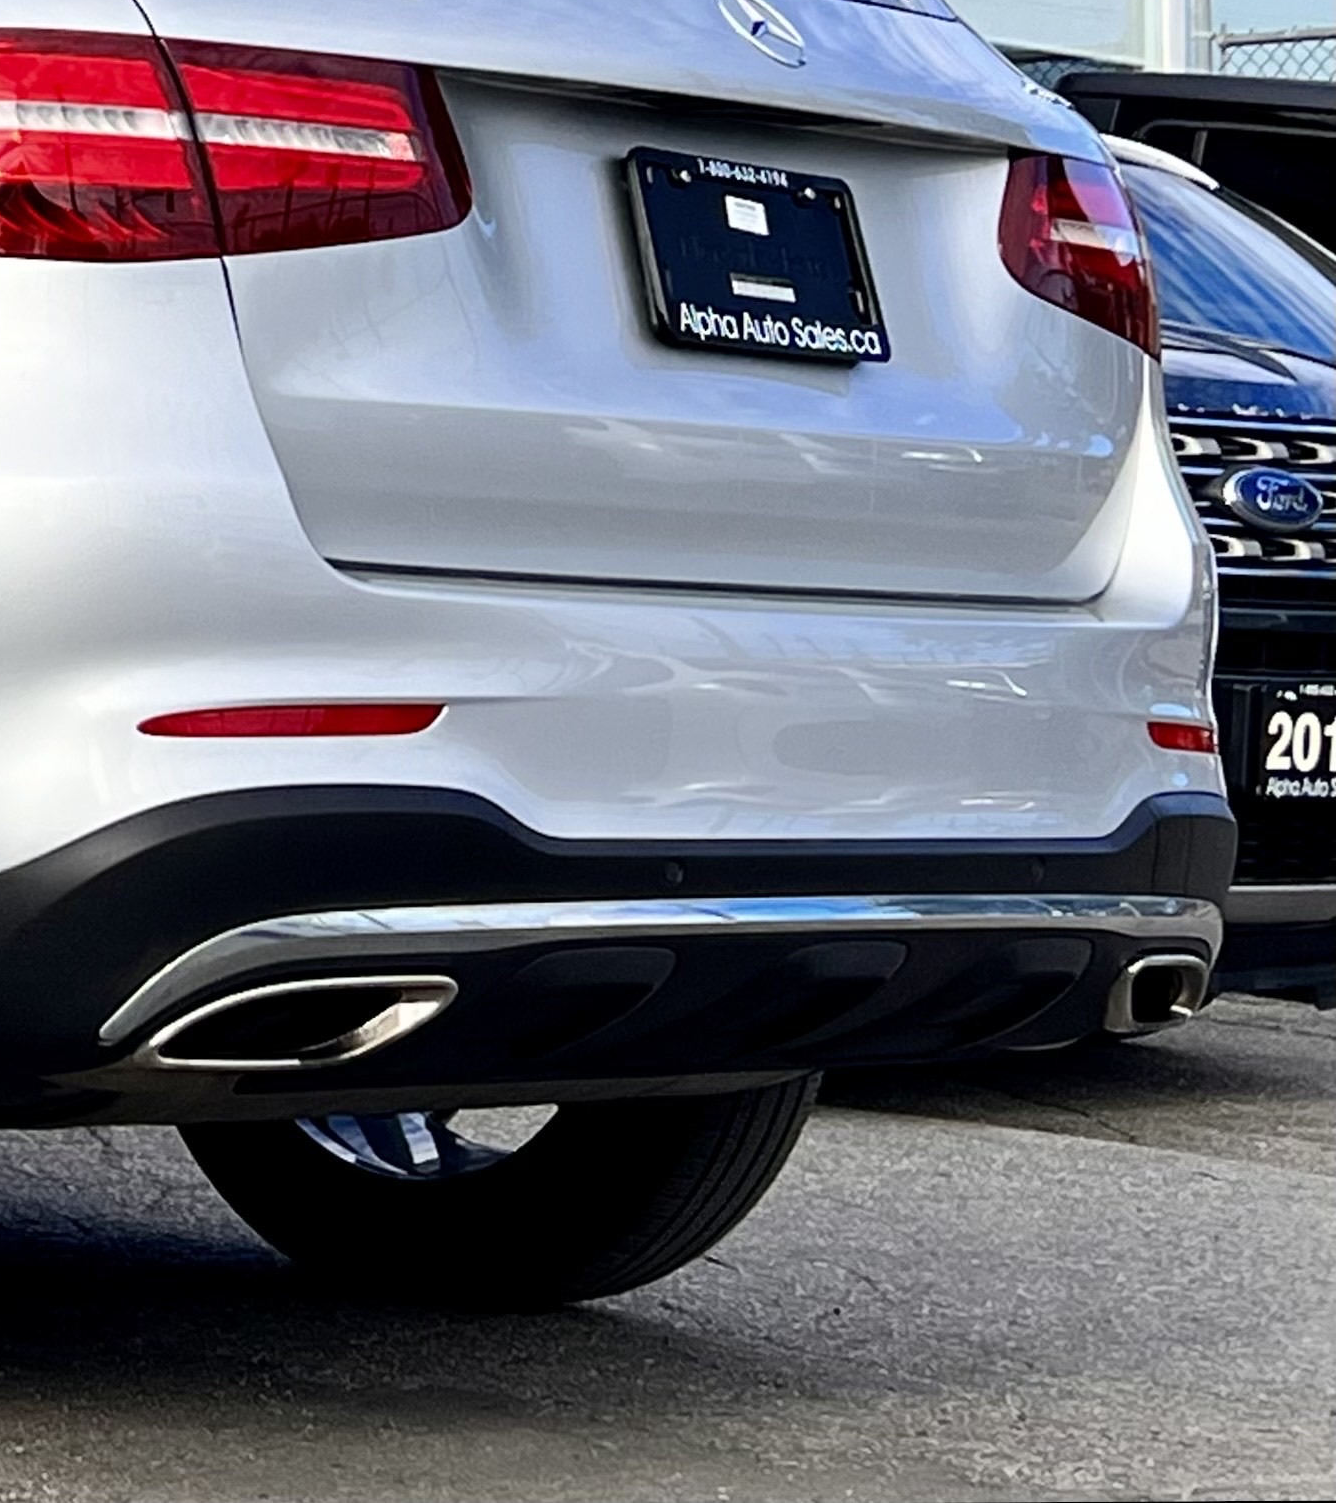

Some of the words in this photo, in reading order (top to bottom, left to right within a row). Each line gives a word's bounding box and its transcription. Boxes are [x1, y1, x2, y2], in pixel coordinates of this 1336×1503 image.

[680, 302, 740, 341] Alpha
[743, 312, 790, 346] Auto
[791, 317, 882, 355] Sales.ca
[1256, 475, 1309, 511] Ford
